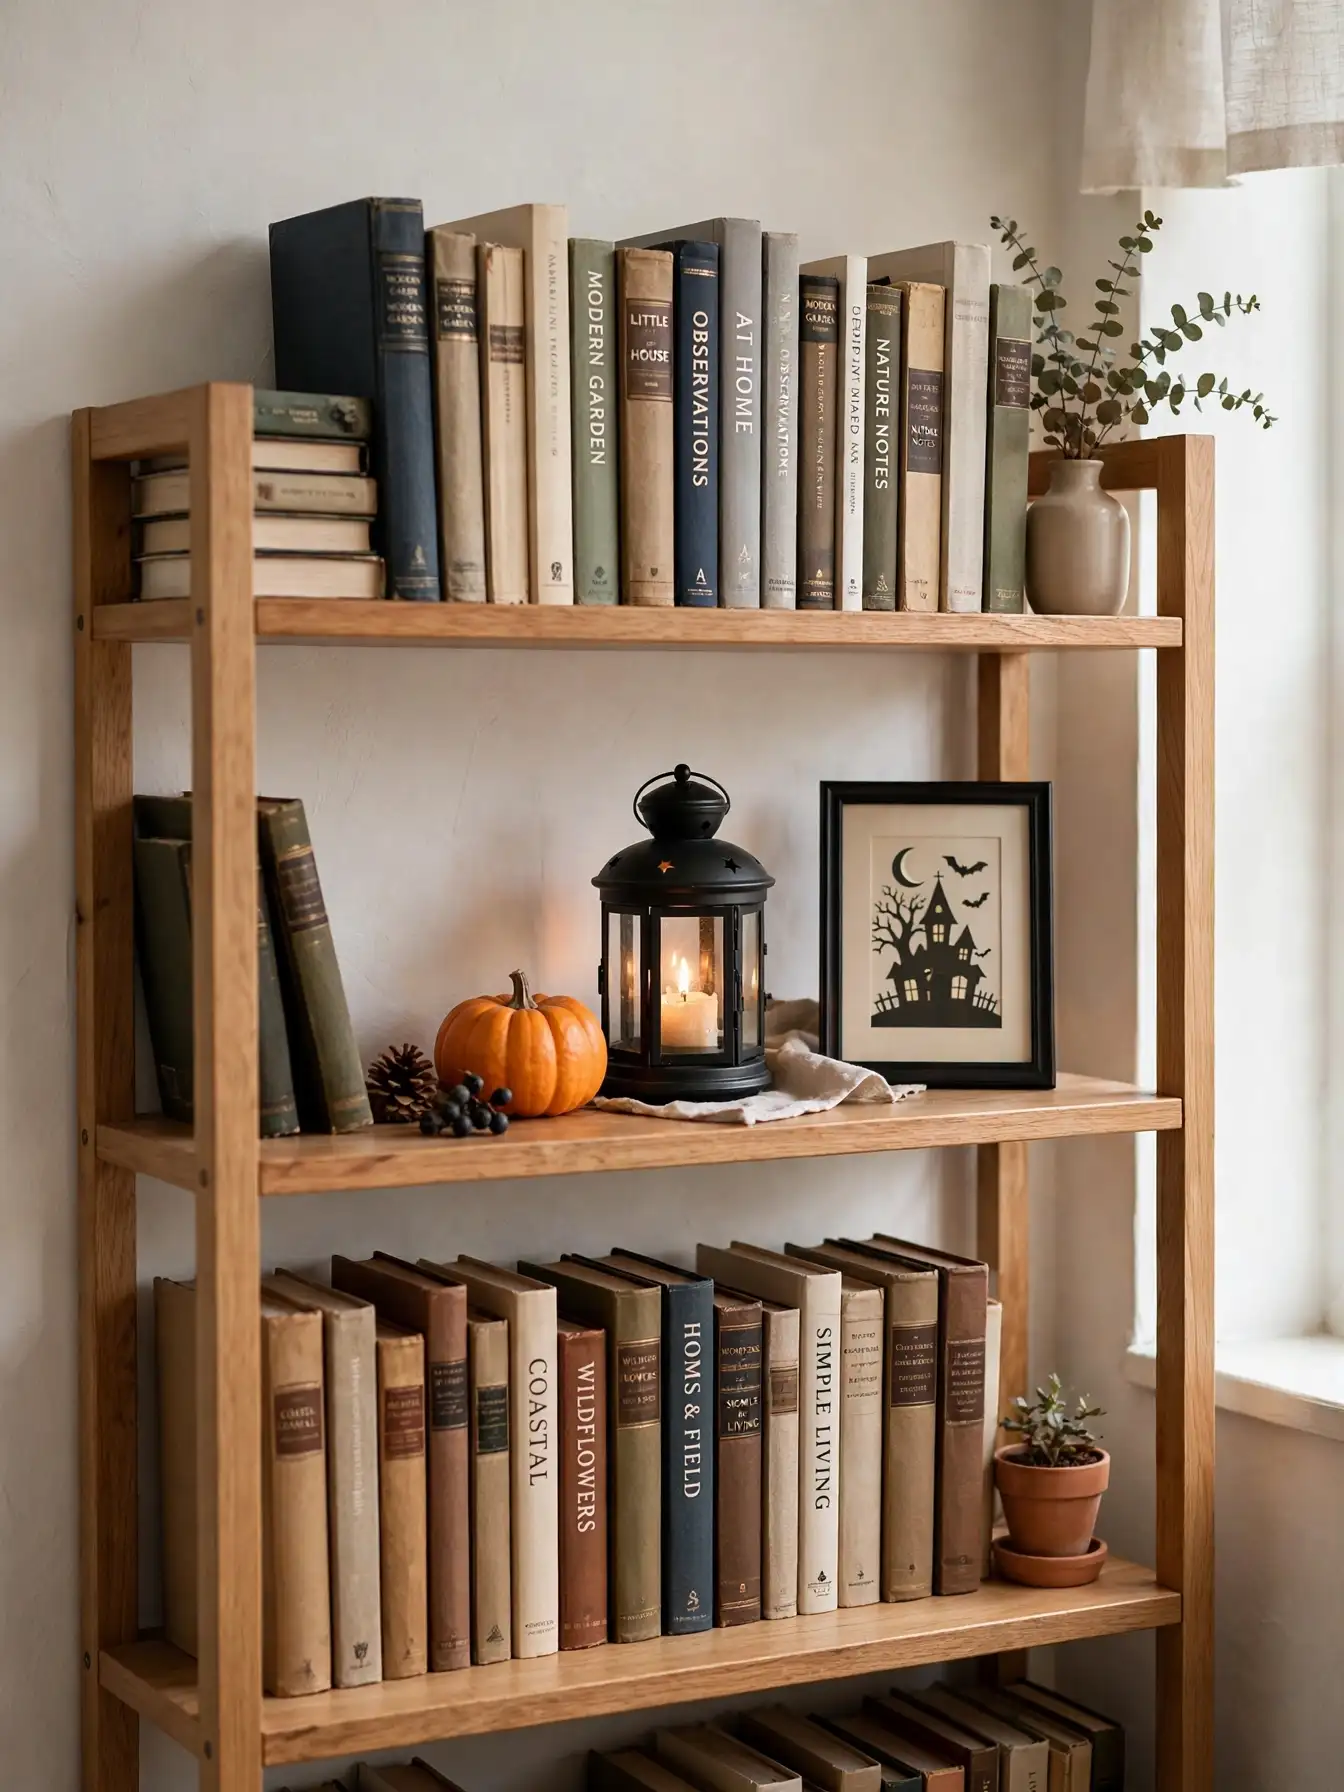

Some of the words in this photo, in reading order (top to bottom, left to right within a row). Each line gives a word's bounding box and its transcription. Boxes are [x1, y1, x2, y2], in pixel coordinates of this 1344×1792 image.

[587, 270, 605, 366] MODERN
[630, 313, 669, 328] LITTLE
[630, 348, 670, 364] HOUSE
[736, 310, 753, 346] AT
[692, 310, 709, 487] OBSERVATIONS
[735, 356, 753, 434] HOME
[876, 338, 891, 417] NATURE
[588, 375, 606, 465] GARDEN
[875, 424, 890, 489] NOTES
[684, 1322, 701, 1395] HOMS
[815, 1327, 832, 1416] SIMPLE
[528, 1358, 549, 1487] COASTAL
[577, 1361, 596, 1533] WILDFLOWERS
[684, 1403, 701, 1420] &
[684, 1428, 701, 1498] FIELD
[814, 1425, 831, 1511] LIVING
